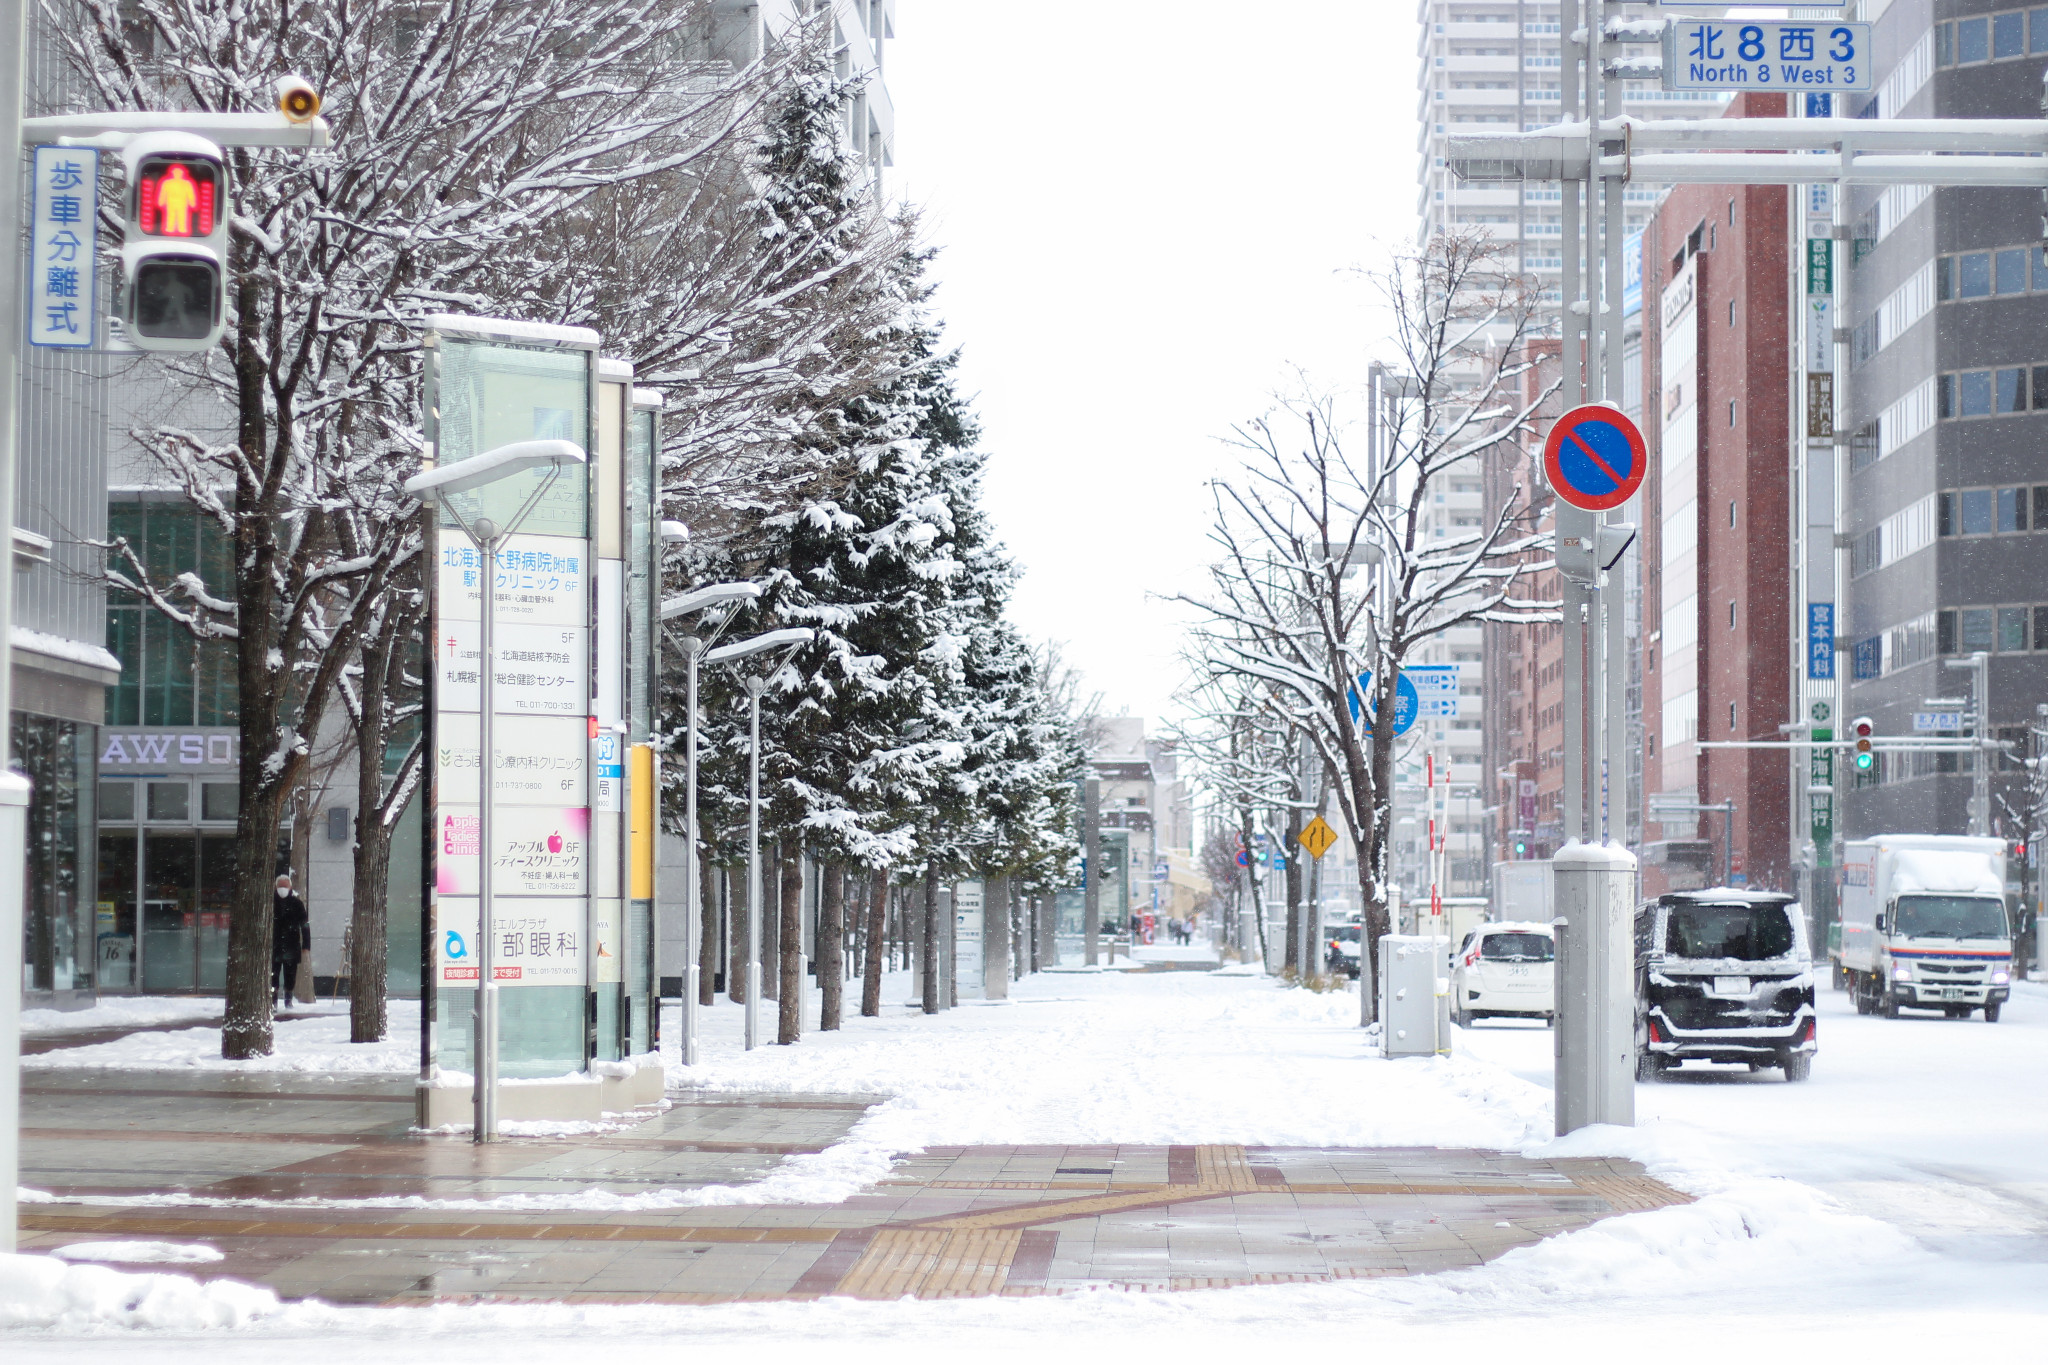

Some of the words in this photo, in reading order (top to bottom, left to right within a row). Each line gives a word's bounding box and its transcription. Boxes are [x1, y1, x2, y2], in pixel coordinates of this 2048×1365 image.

[1688, 25, 1855, 62] 北8西3
[1690, 63, 1748, 82] North
[1758, 64, 1770, 83] 8
[1781, 65, 1833, 84] West
[1844, 66, 1856, 84] 3
[46, 159, 83, 334] 歩車分離式
[1812, 240, 1827, 294] 西松建設
[463, 570, 560, 591] 駅クリニック
[564, 580, 579, 592] 6F
[561, 632, 575, 644] 5F
[1813, 605, 1830, 676] 宮本内科
[501, 650, 570, 664] 北海道結核予防会
[515, 700, 528, 709] TEL
[98, 734, 240, 765] AWSO
[560, 779, 575, 791] 6F
[444, 815, 480, 829] Apple
[444, 830, 480, 842] Ladies
[507, 841, 545, 853] アップル
[566, 841, 580, 853] 6F
[494, 855, 580, 868] ディースクリニック
[525, 882, 536, 890] TEL
[527, 967, 539, 975] TEL
